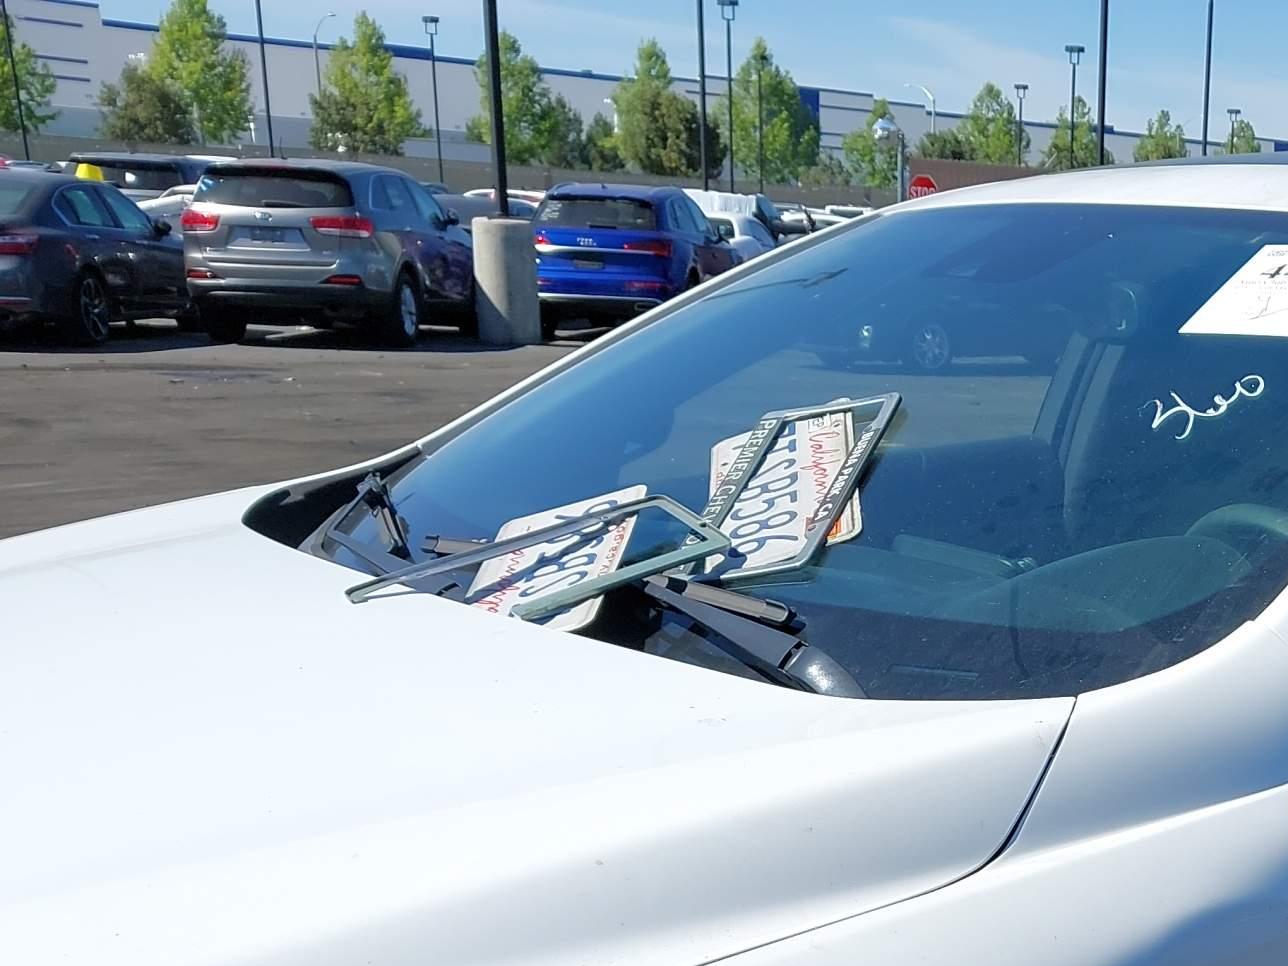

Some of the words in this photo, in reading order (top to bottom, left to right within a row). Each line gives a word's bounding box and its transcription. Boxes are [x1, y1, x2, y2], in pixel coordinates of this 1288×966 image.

[727, 420, 777, 480] PREMIER
[845, 431, 875, 467] BUENA
[814, 503, 833, 520] CA
